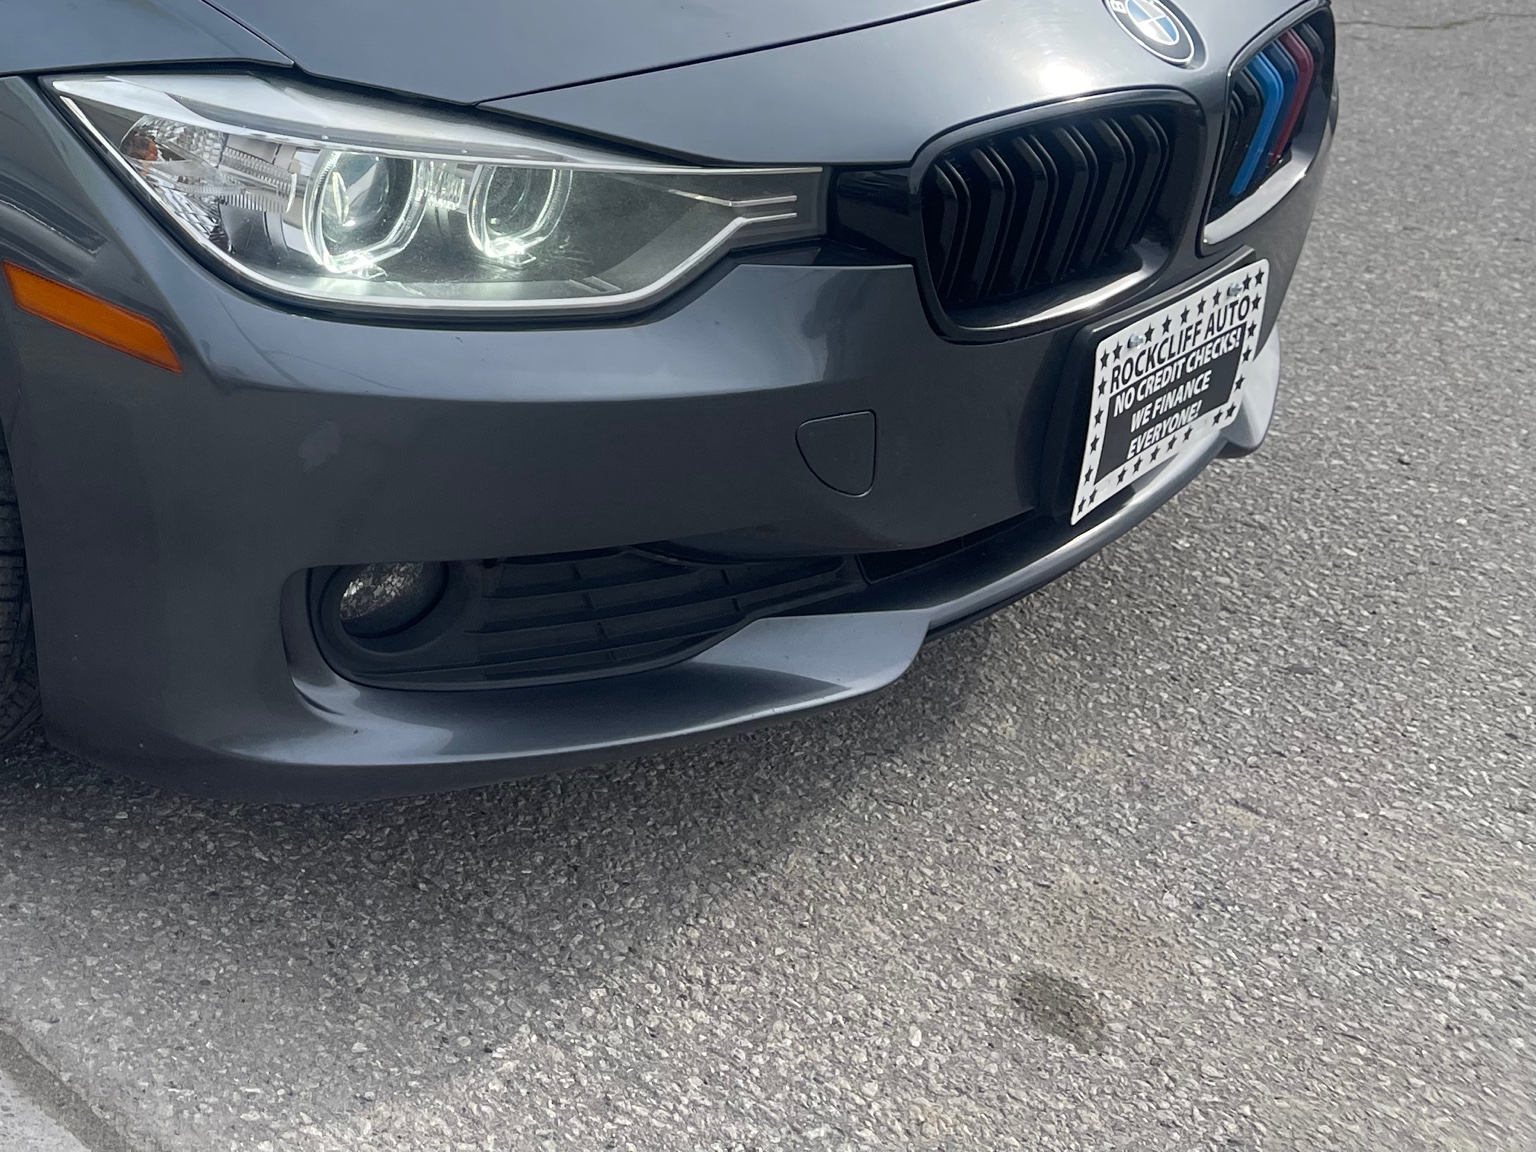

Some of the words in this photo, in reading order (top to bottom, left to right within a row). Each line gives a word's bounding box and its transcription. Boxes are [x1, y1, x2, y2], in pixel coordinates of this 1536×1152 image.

[1110, 320, 1202, 394] ROCKCLIFF
[1204, 295, 1251, 341] AUTO
[1114, 390, 1135, 418] NO
[1136, 358, 1186, 402] CREDIT
[1186, 333, 1241, 378] CHECKS!
[1127, 400, 1203, 460] EVERYONE!
[1131, 408, 1152, 433] WE
[1152, 369, 1212, 419] FINANCE
